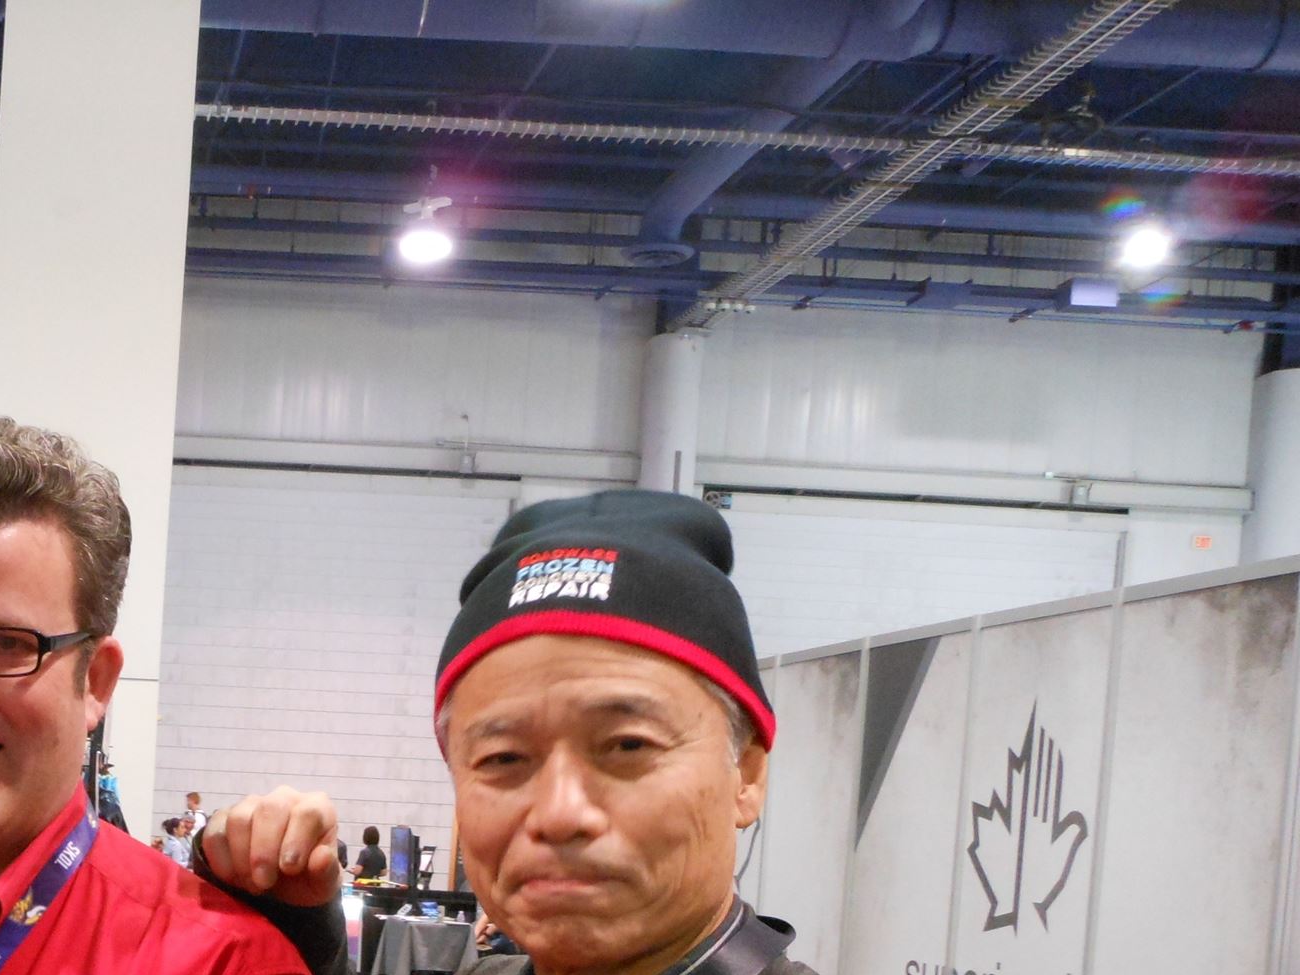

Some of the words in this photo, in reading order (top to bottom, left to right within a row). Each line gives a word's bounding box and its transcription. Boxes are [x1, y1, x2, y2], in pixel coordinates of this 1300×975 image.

[516, 558, 614, 582] FROZEN
[508, 581, 610, 609] REPAIR
[54, 841, 81, 870] SKOL
